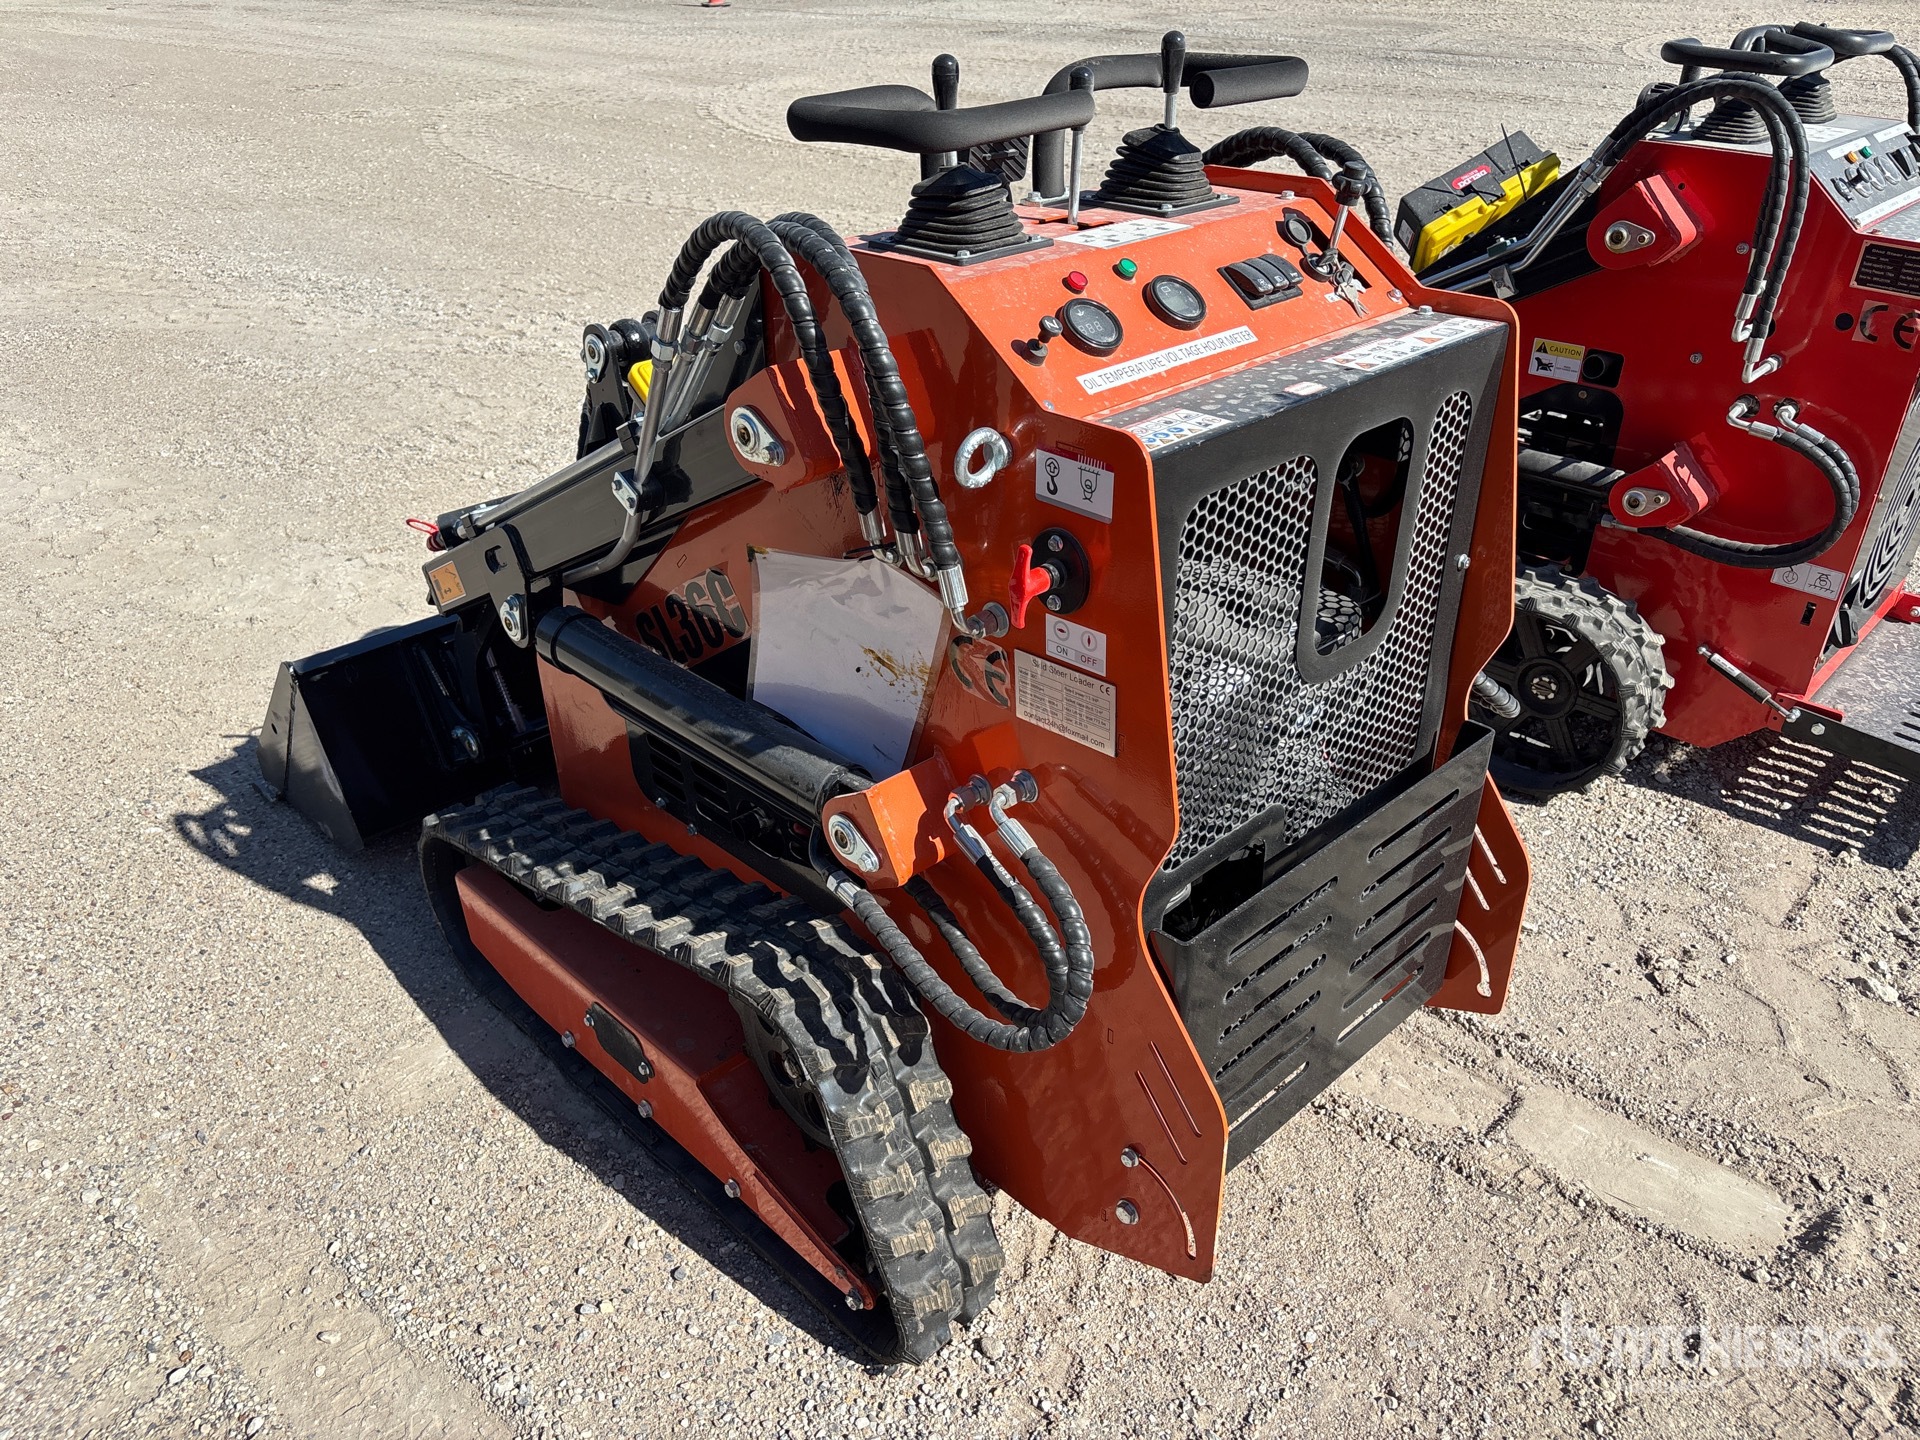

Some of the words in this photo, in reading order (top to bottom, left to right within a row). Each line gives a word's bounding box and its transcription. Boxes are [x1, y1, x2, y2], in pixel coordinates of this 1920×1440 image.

[1083, 376, 1102, 390] OIL
[1098, 356, 1166, 385] TEMPERATURE
[1162, 344, 1204, 366] VOLTAGE
[1200, 337, 1230, 354] HOUR
[1227, 329, 1255, 346] METER
[1549, 345, 1582, 357] CAUTION
[636, 567, 748, 665] SL36C
[1055, 645, 1068, 656] ON
[1080, 654, 1097, 666] OFF
[1031, 658, 1047, 671] Skid
[1048, 665, 1068, 679] Steer
[1069, 673, 1095, 689] Loader
